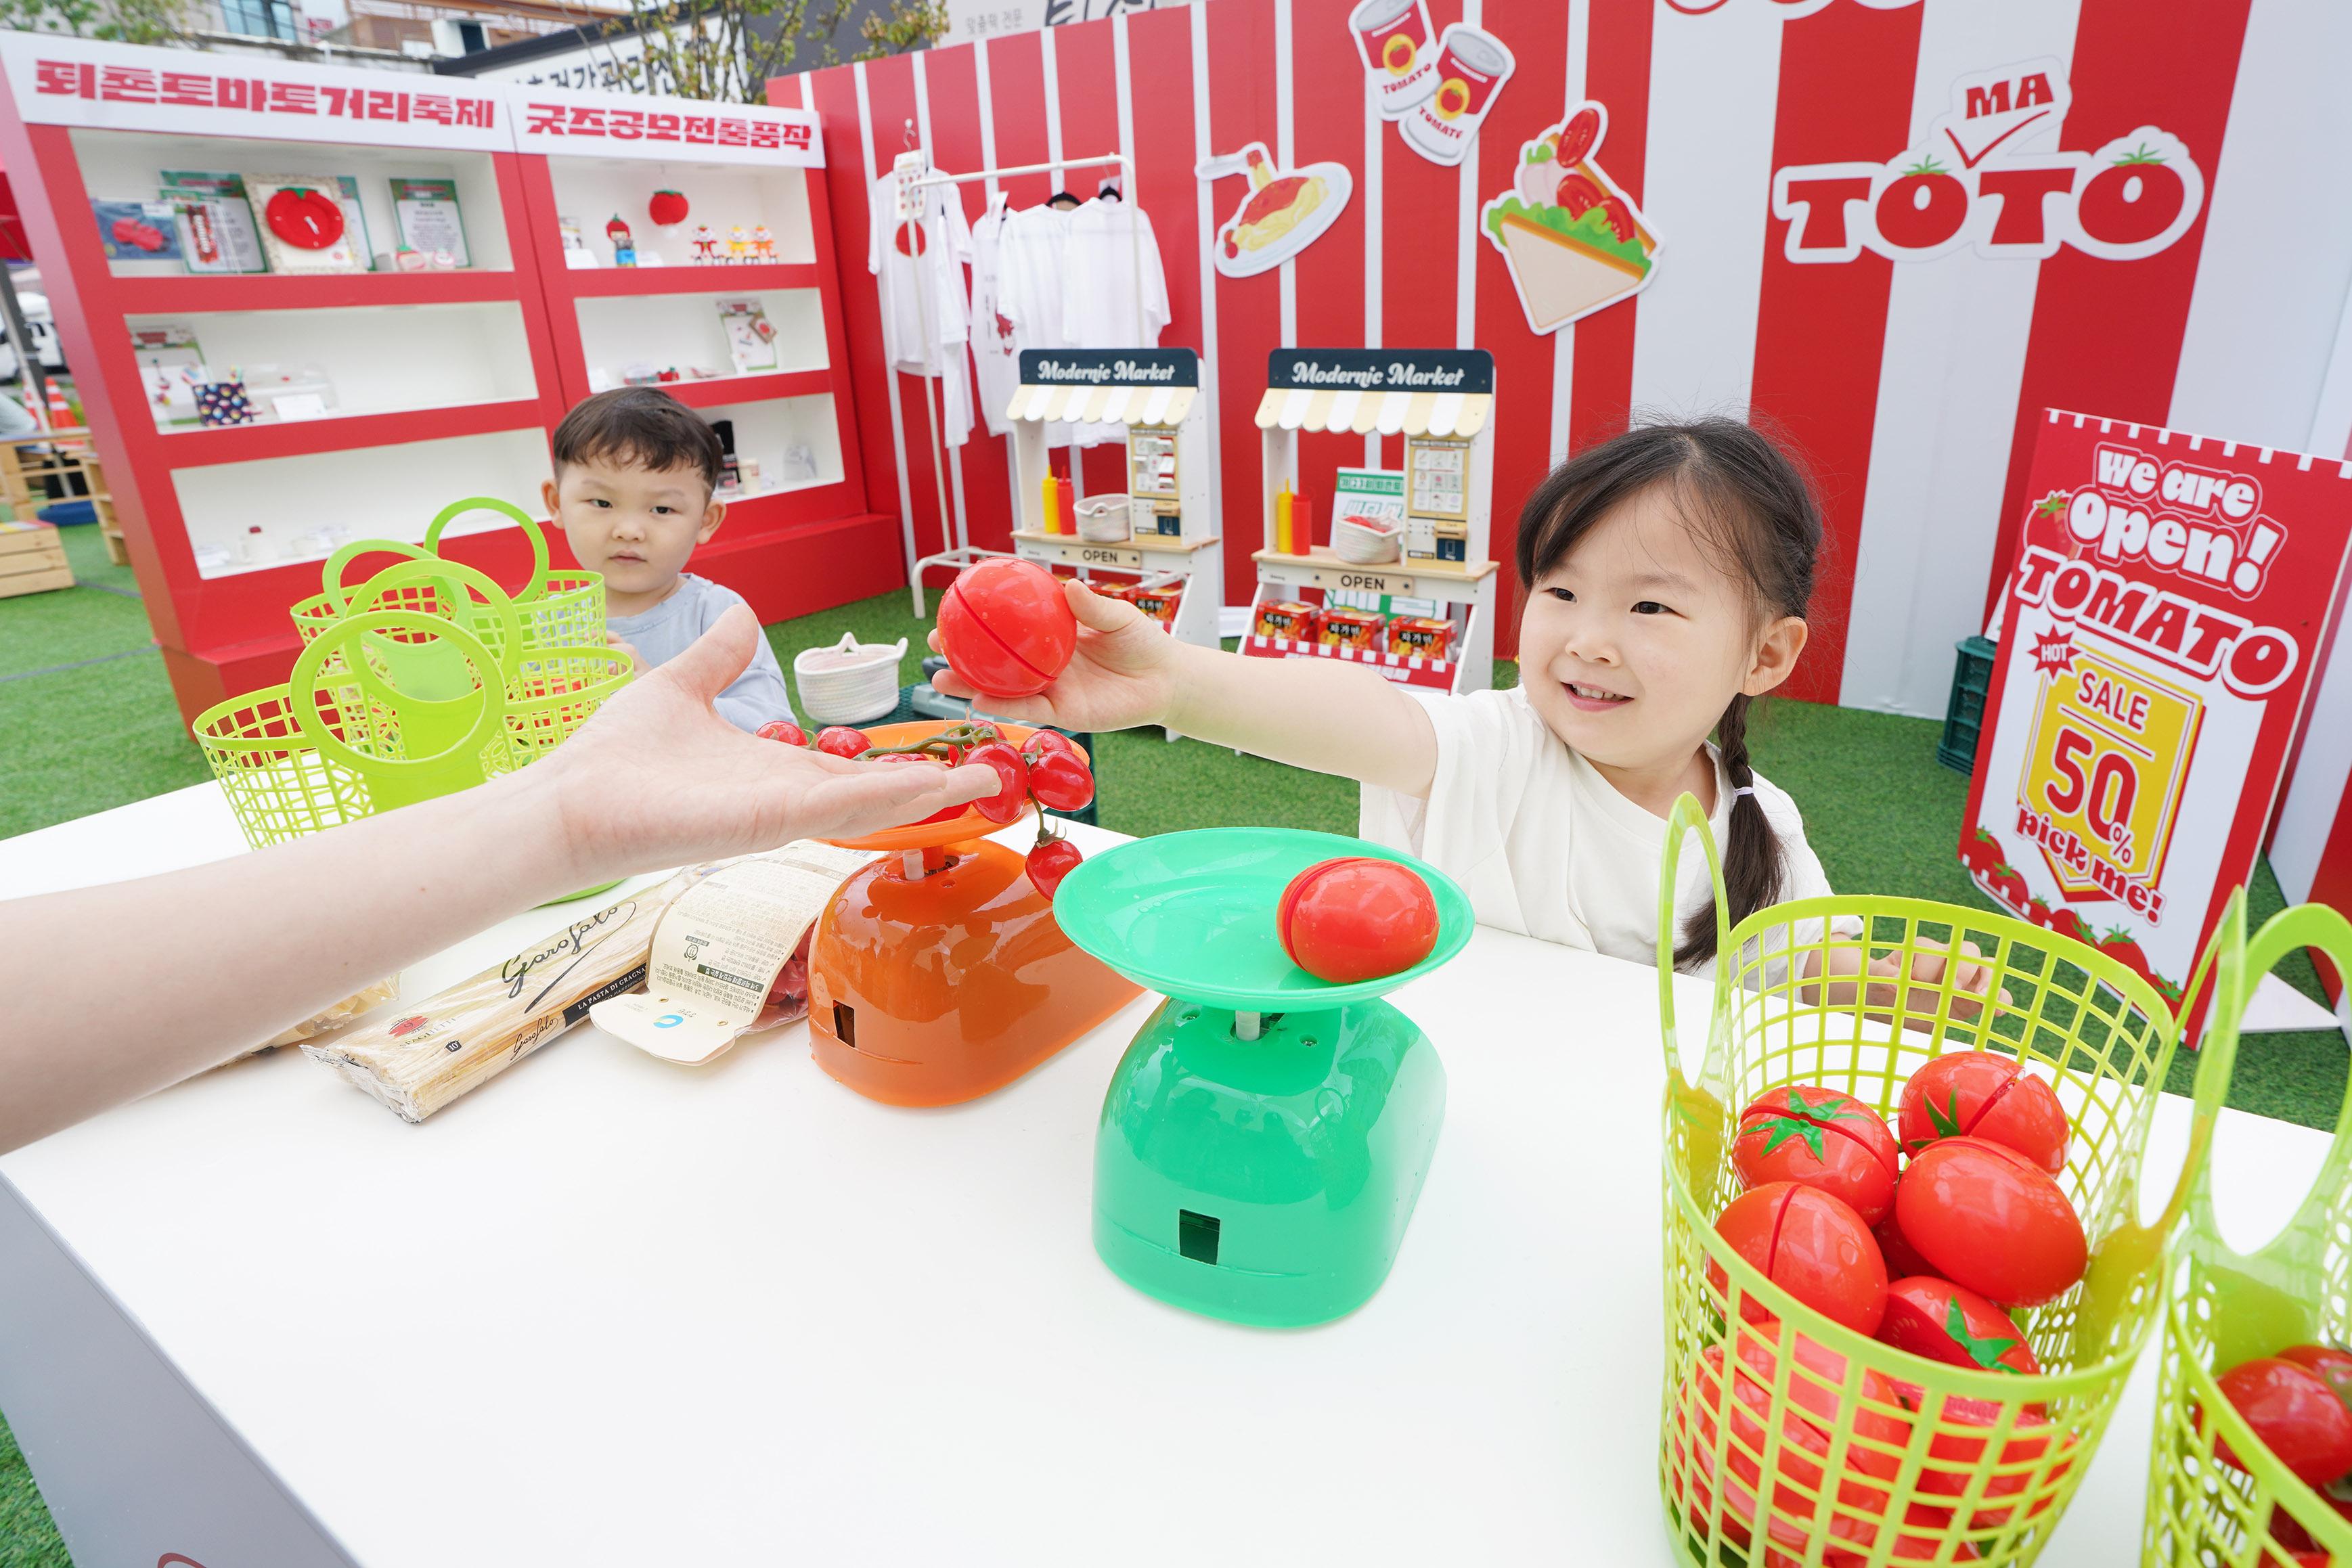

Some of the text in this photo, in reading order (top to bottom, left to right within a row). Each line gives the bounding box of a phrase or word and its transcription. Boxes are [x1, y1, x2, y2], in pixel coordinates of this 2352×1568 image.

[37, 59, 494, 129] 퇴촌토마토거리축제
[1382, 64, 1432, 94] TOMATO
[1966, 72, 2054, 120] MA
[527, 103, 811, 151] 굿즈공모전출품작
[1787, 157, 2185, 249] TOTO
[1038, 359, 1176, 384] Modernic Market
[1291, 361, 1465, 388] Modernic Market
[2162, 468, 2255, 517] are
[1083, 550, 1118, 563] OPEN
[1341, 575, 1385, 590] OPEN
[2018, 550, 2290, 687] TOMATO
[2040, 644, 2069, 663] HOT
[2079, 672, 2150, 731] SALE
[2045, 725, 2137, 865] 50%
[2016, 809, 2164, 924] pick me!
[502, 903, 621, 1000] Garofalo
[577, 967, 646, 1010] LA PASTA DI GRAGNA
[510, 1014, 556, 1062] Garofalo
